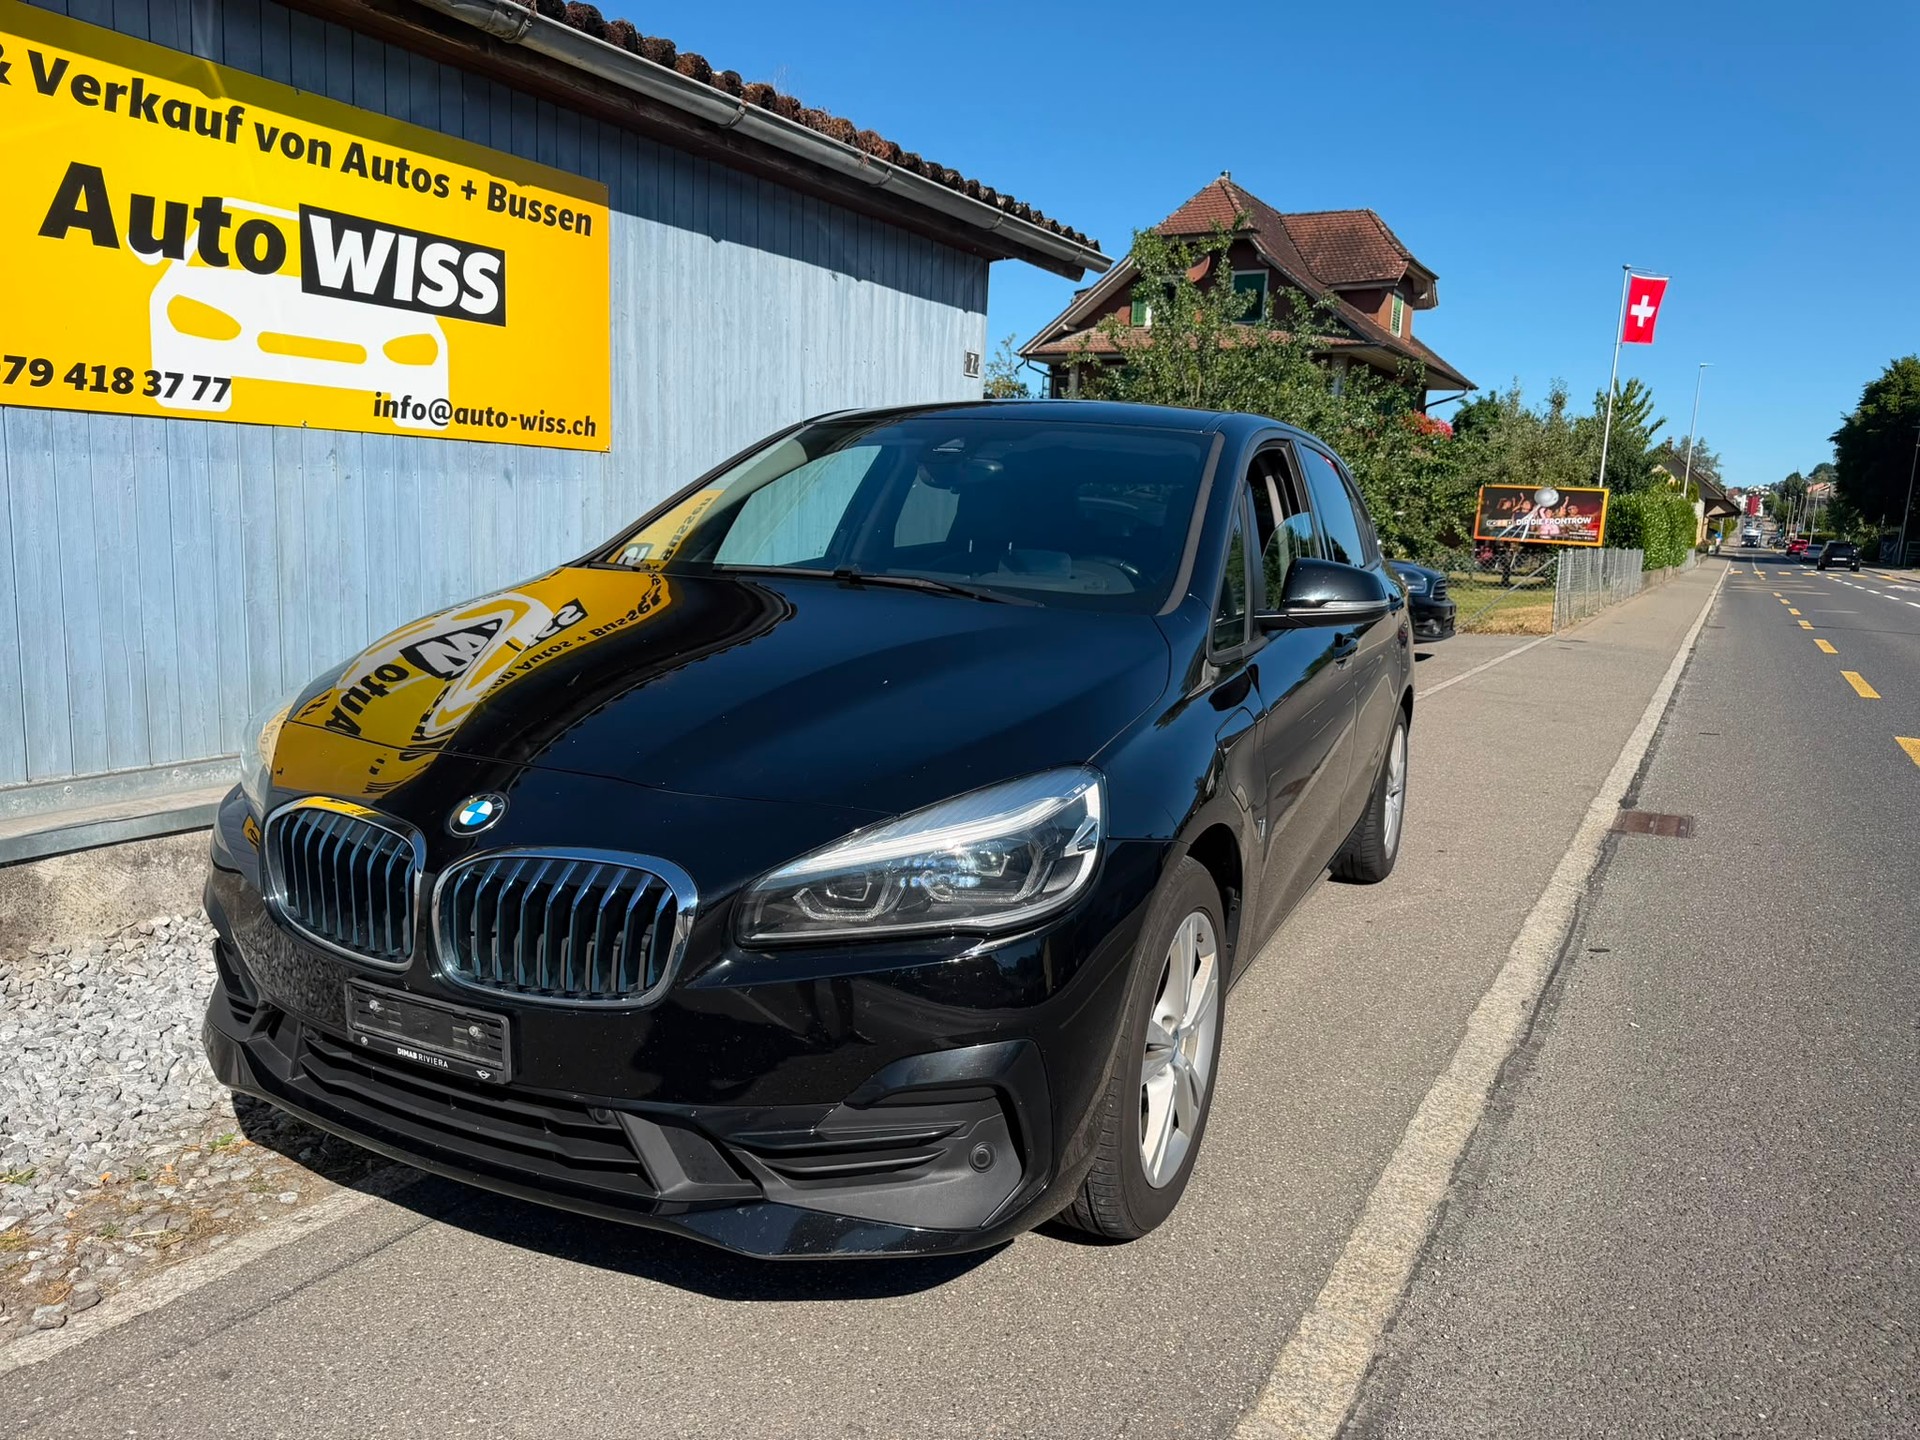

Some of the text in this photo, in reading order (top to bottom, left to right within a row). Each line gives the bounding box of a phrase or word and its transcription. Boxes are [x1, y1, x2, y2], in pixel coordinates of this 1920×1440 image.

[27, 49, 246, 144] Verkauf
[254, 122, 332, 169] von
[340, 142, 450, 199] Autos
[460, 179, 477, 201] +
[487, 181, 593, 237] Bussen
[37, 161, 501, 316] Auto WISS
[0, 354, 232, 403] 79 418 37 77
[373, 391, 597, 438] info@auto-wiss.ch
[1544, 516, 1592, 526] FRONTROW
[397, 1047, 449, 1069] DIMAB RIVIERA
